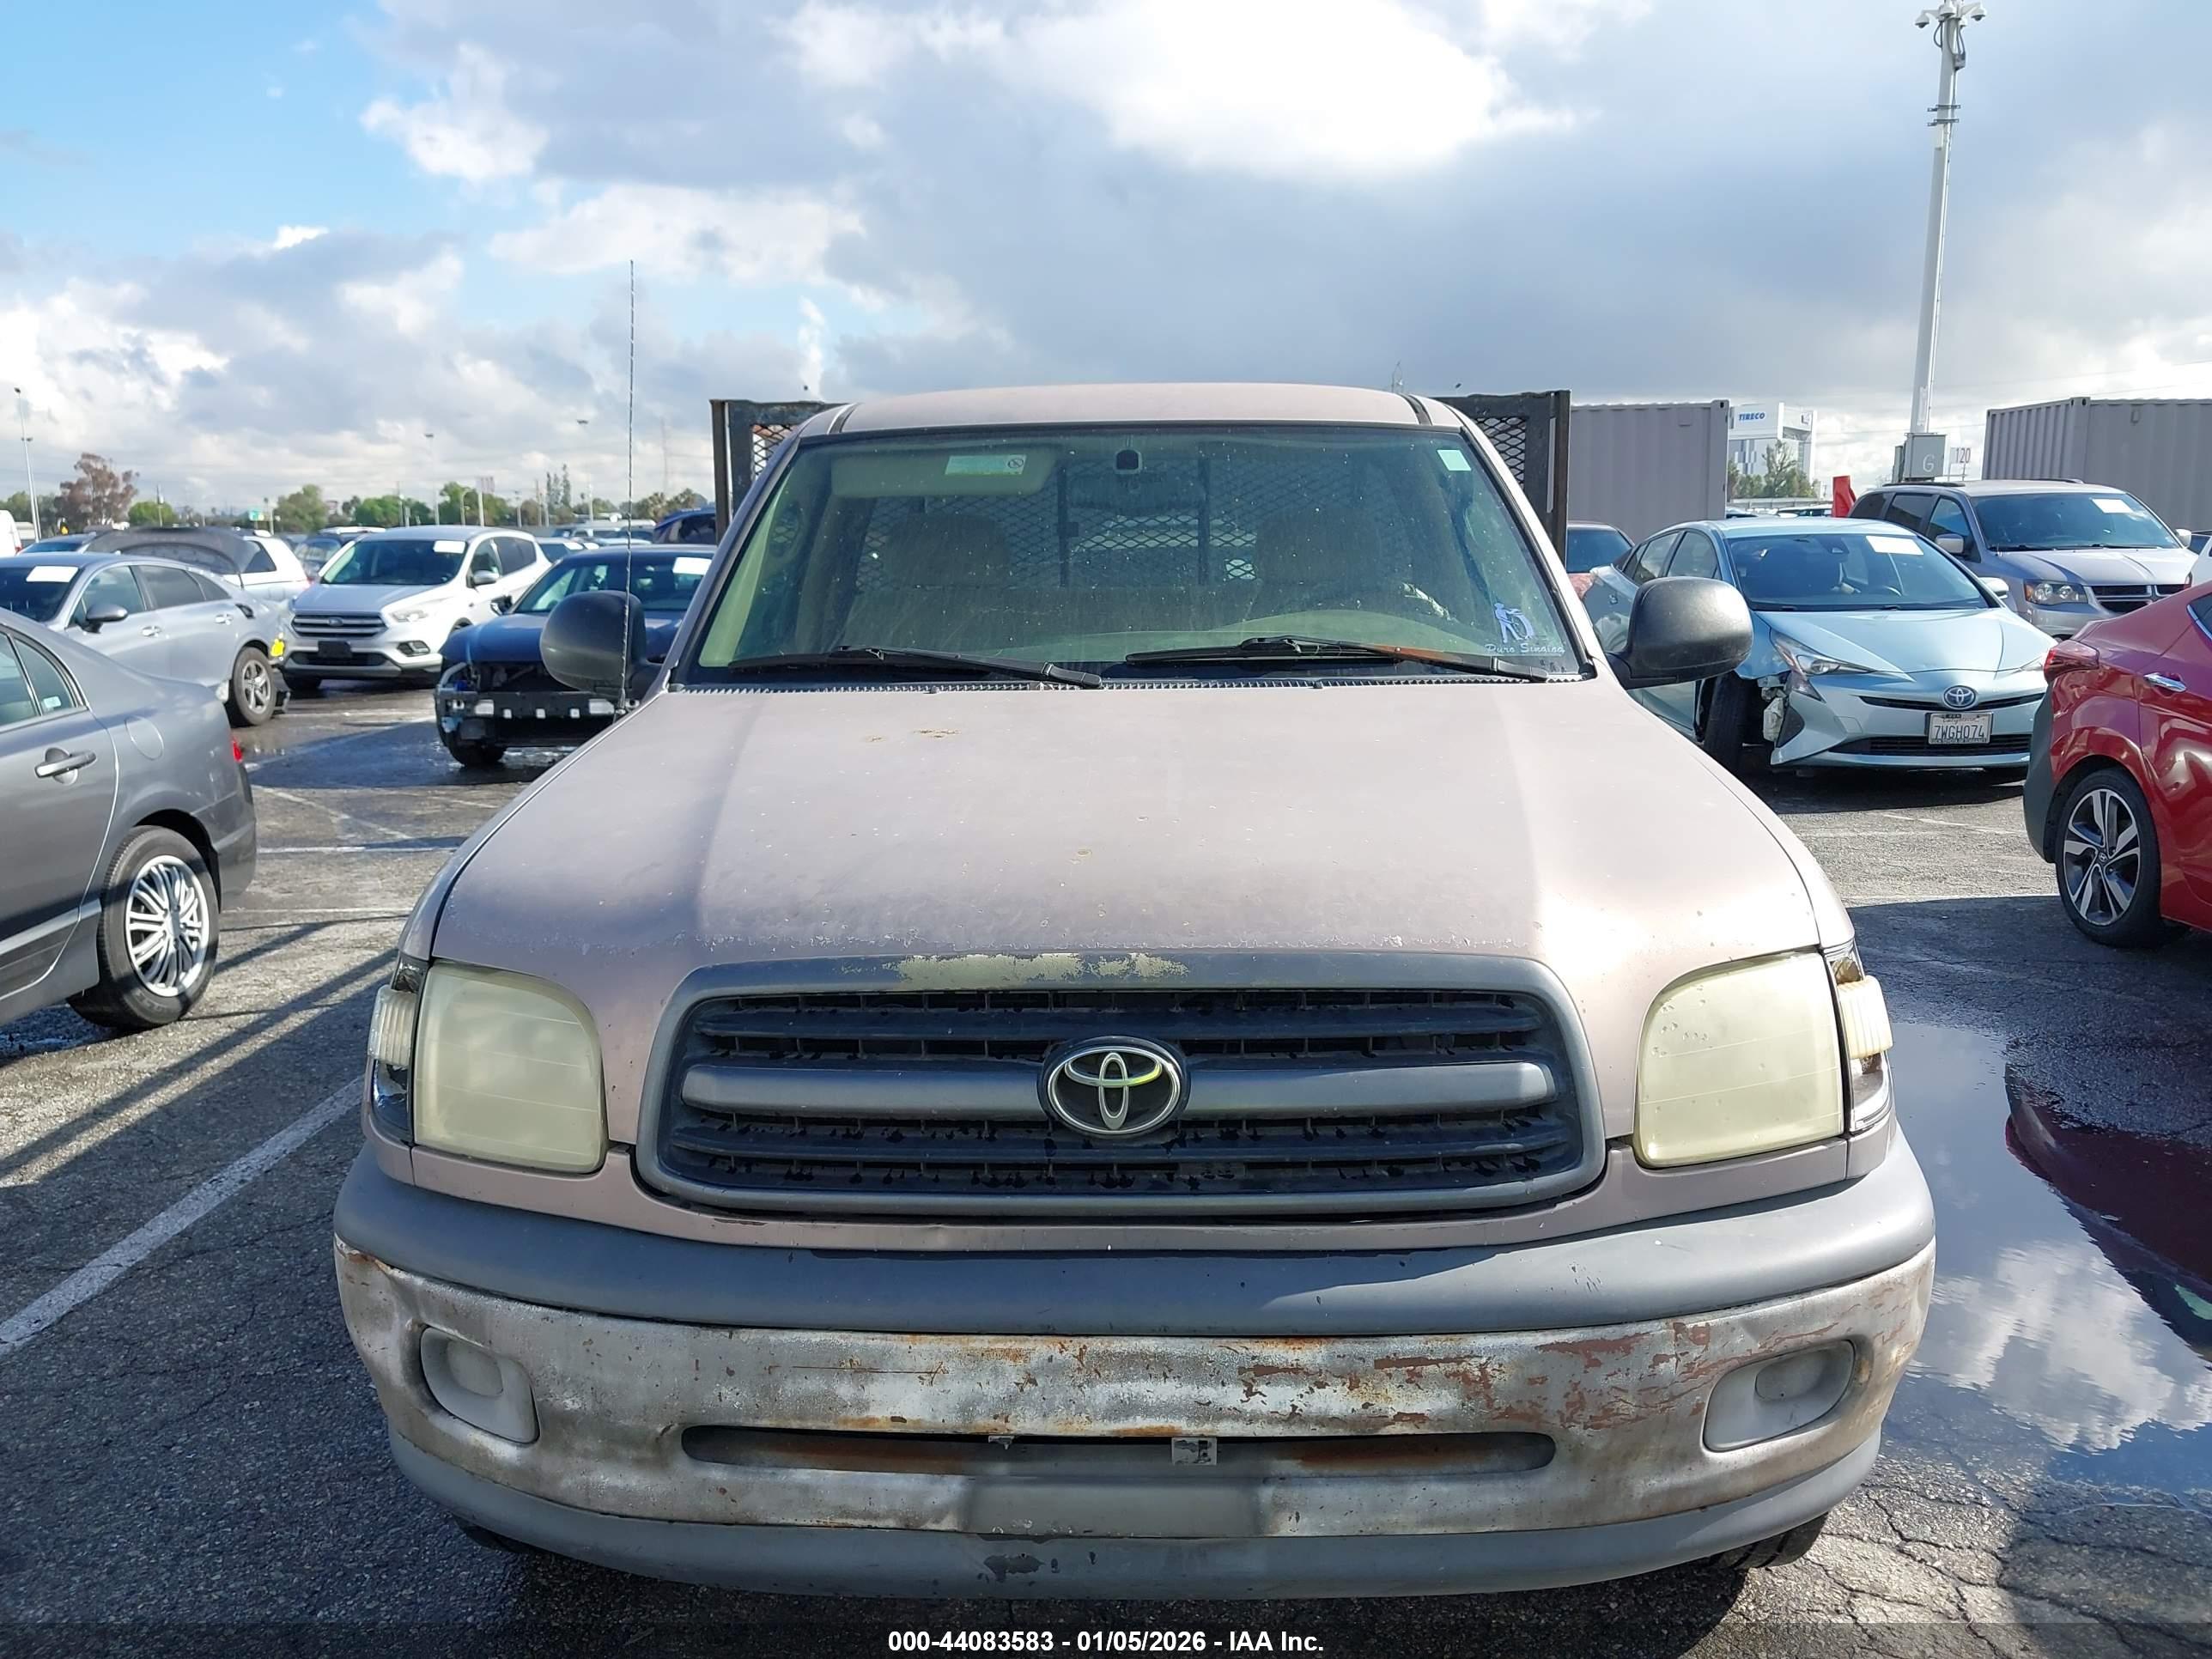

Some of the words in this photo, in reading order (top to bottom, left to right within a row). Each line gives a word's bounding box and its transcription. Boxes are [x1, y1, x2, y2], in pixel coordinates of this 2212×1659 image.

[1739, 412, 1765, 421] TIRECO
[1923, 453, 1935, 472] G
[1956, 447, 1972, 464] 120
[1935, 725, 1985, 740] 7WGH074
